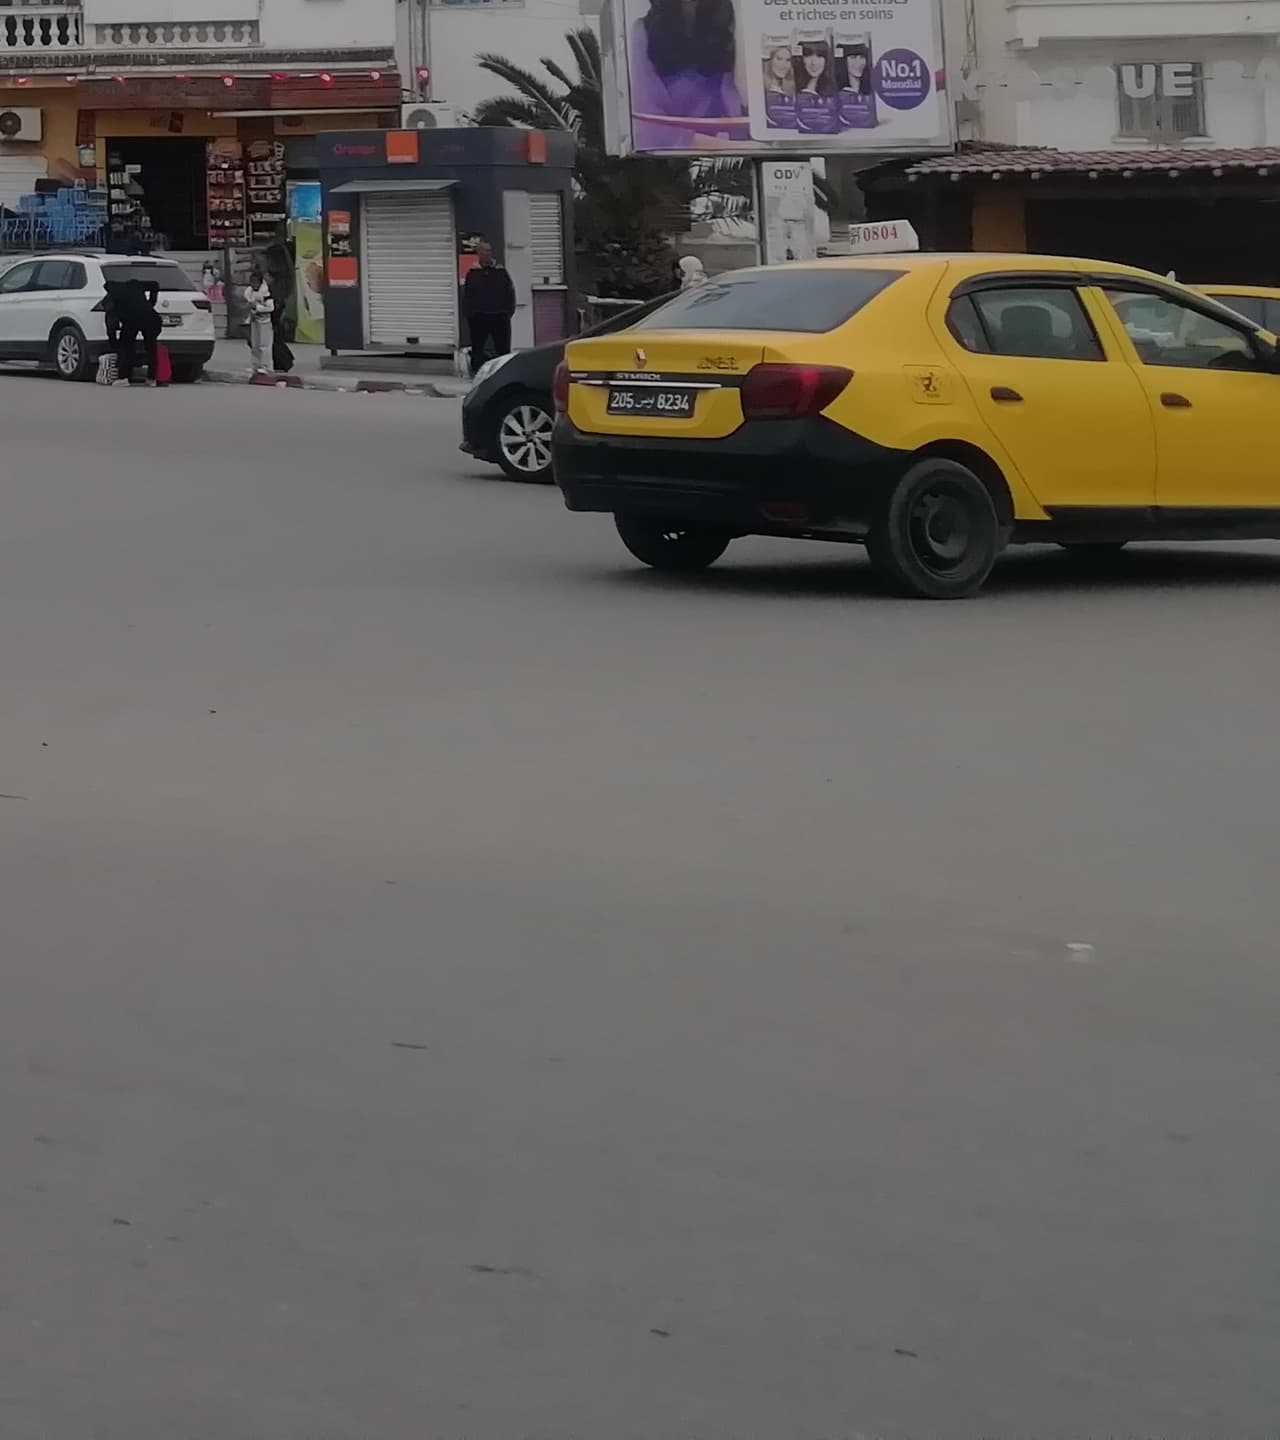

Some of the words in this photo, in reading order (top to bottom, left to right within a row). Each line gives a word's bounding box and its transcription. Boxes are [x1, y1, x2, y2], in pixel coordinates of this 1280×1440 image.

[779, 10, 794, 21] et
[797, 9, 837, 20] riches
[839, 11, 856, 20] en
[859, 9, 894, 20] soins
[881, 59, 921, 78] No.1
[881, 79, 921, 89] Mondial
[774, 168, 801, 180] ODV
[863, 224, 898, 242] 0804
[610, 392, 634, 409] 205
[656, 393, 689, 411] 8234
